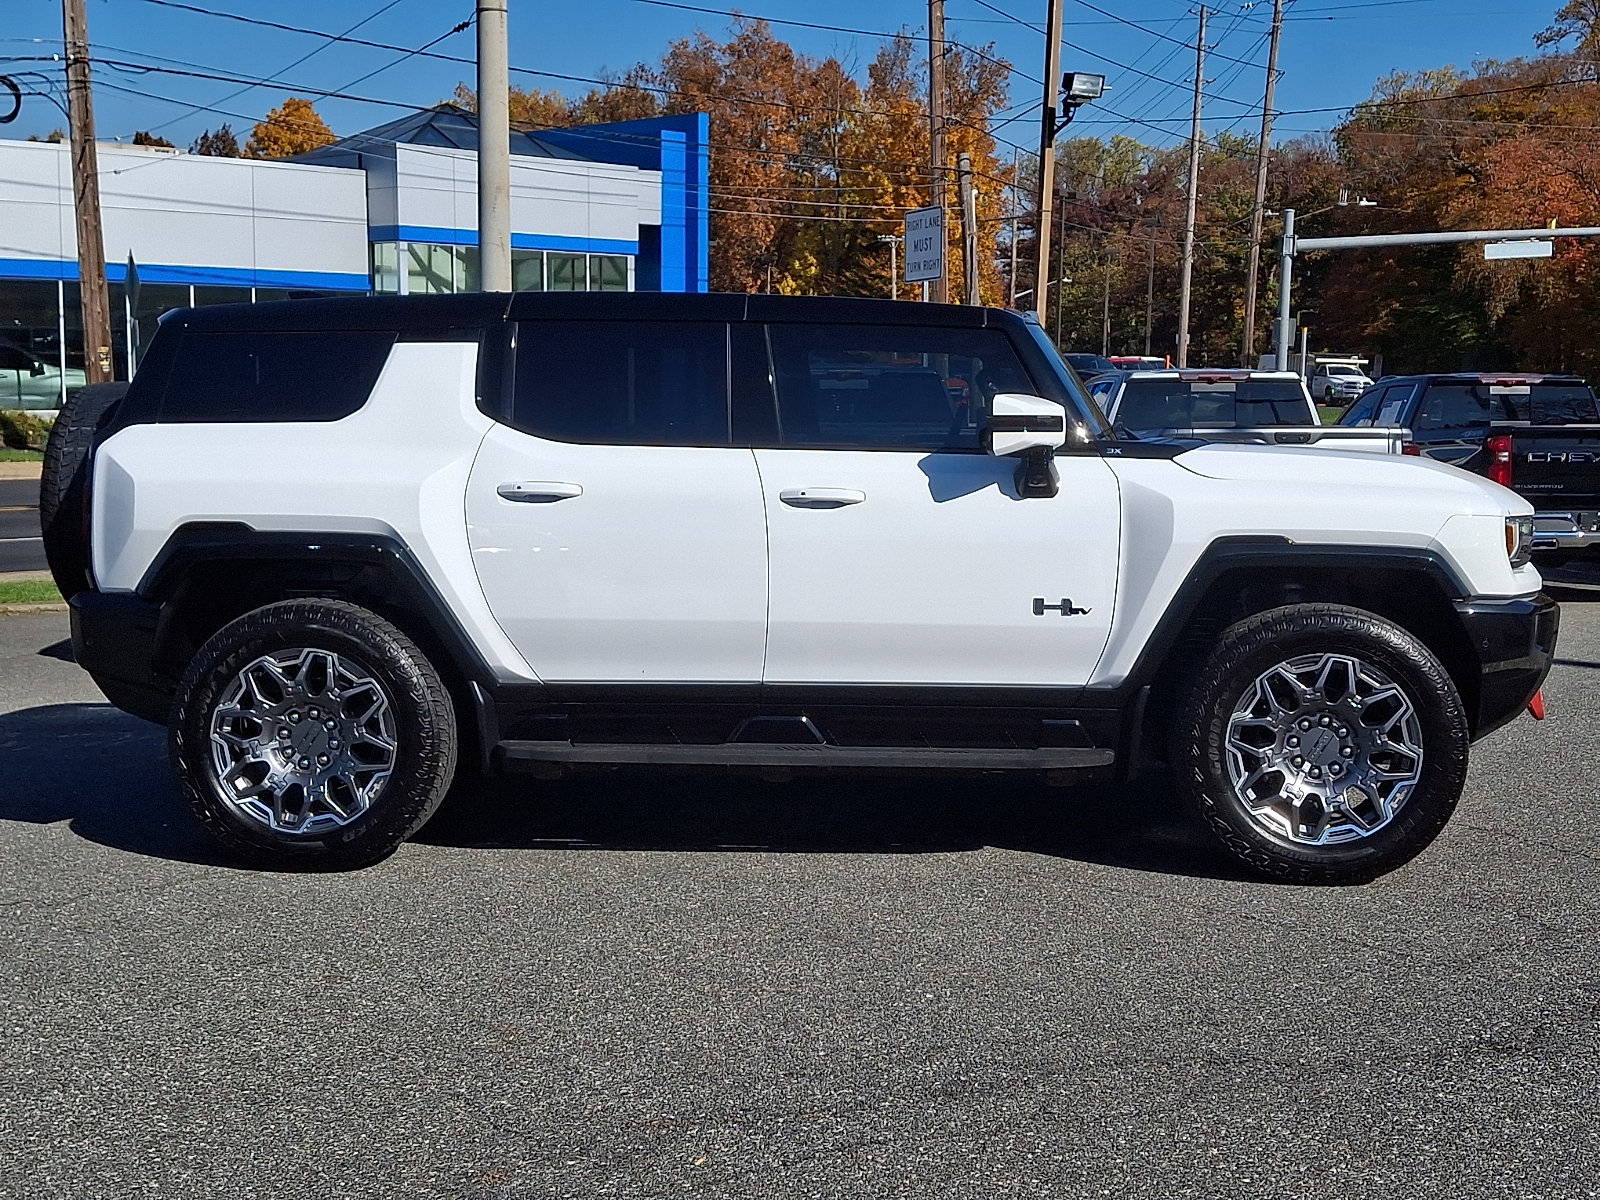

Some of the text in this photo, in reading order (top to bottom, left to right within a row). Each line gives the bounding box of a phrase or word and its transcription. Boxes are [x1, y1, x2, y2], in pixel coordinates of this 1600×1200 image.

[907, 216, 940, 231] RIGHT LANE
[913, 237, 933, 252] MUST
[907, 258, 940, 273] TURN RIGHT
